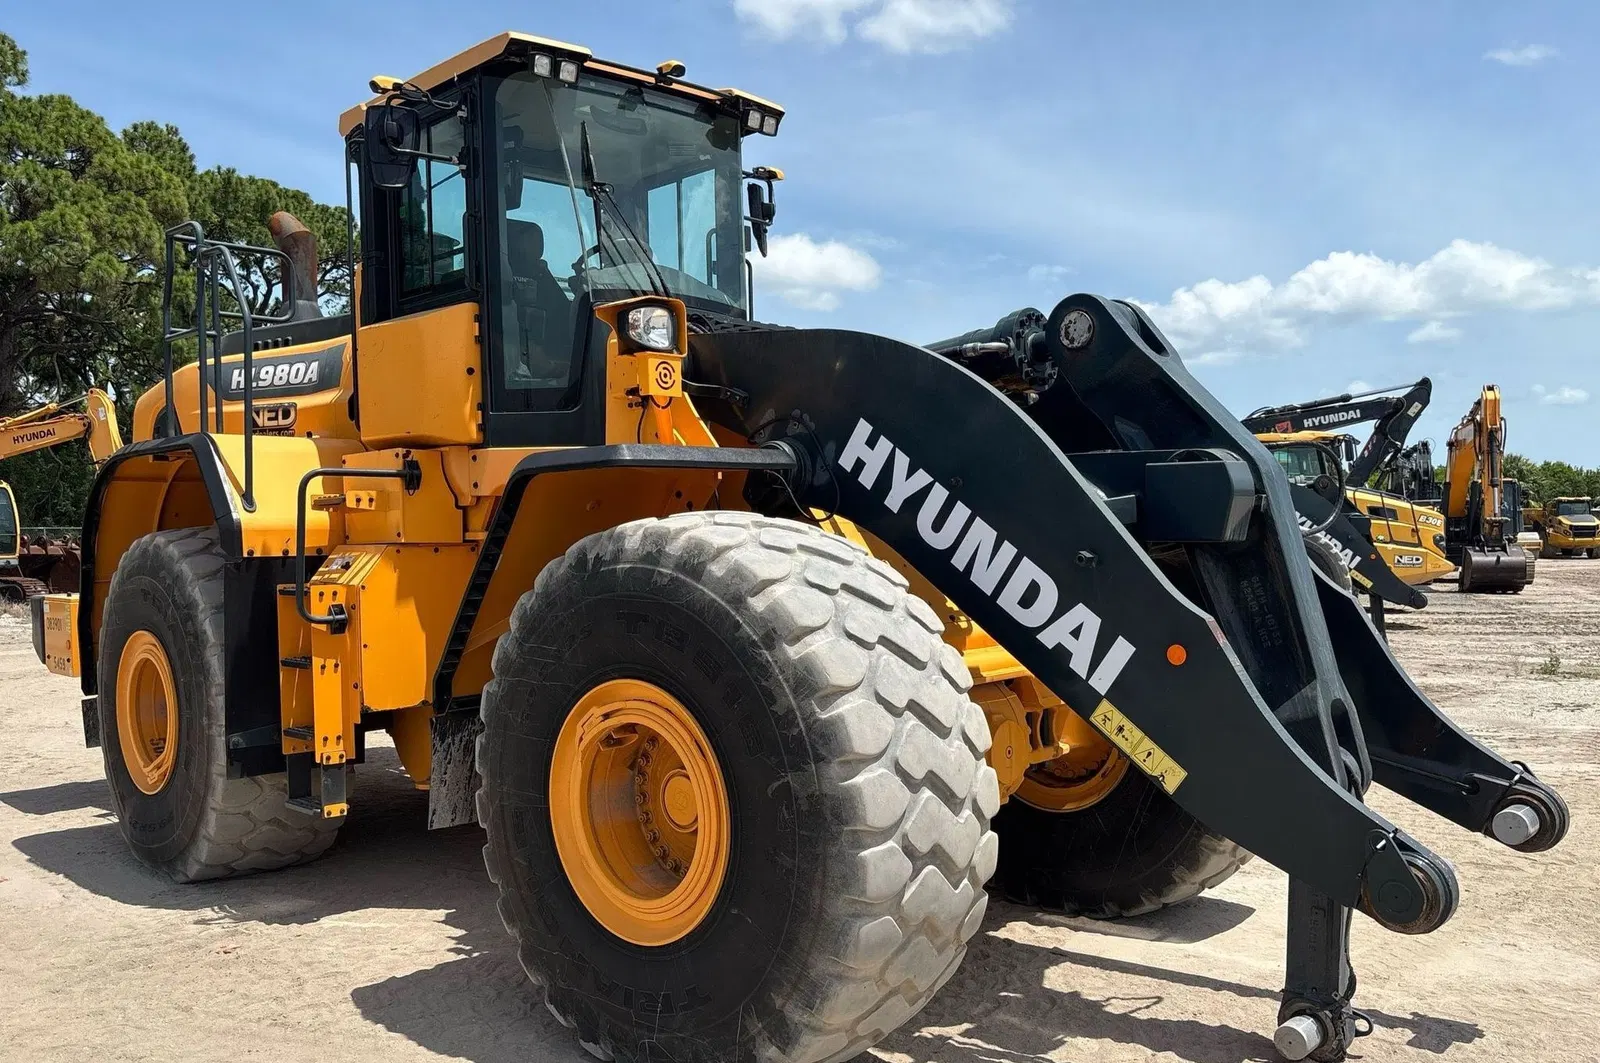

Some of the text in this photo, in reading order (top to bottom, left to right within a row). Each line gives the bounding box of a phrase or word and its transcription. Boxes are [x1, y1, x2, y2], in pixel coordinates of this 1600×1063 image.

[1303, 409, 1361, 428] HYUNDAI
[12, 427, 56, 445] HYUNDAI
[1418, 514, 1443, 527] B30E
[838, 417, 1137, 697] HYUNDAI
[1394, 554, 1423, 564] NED
